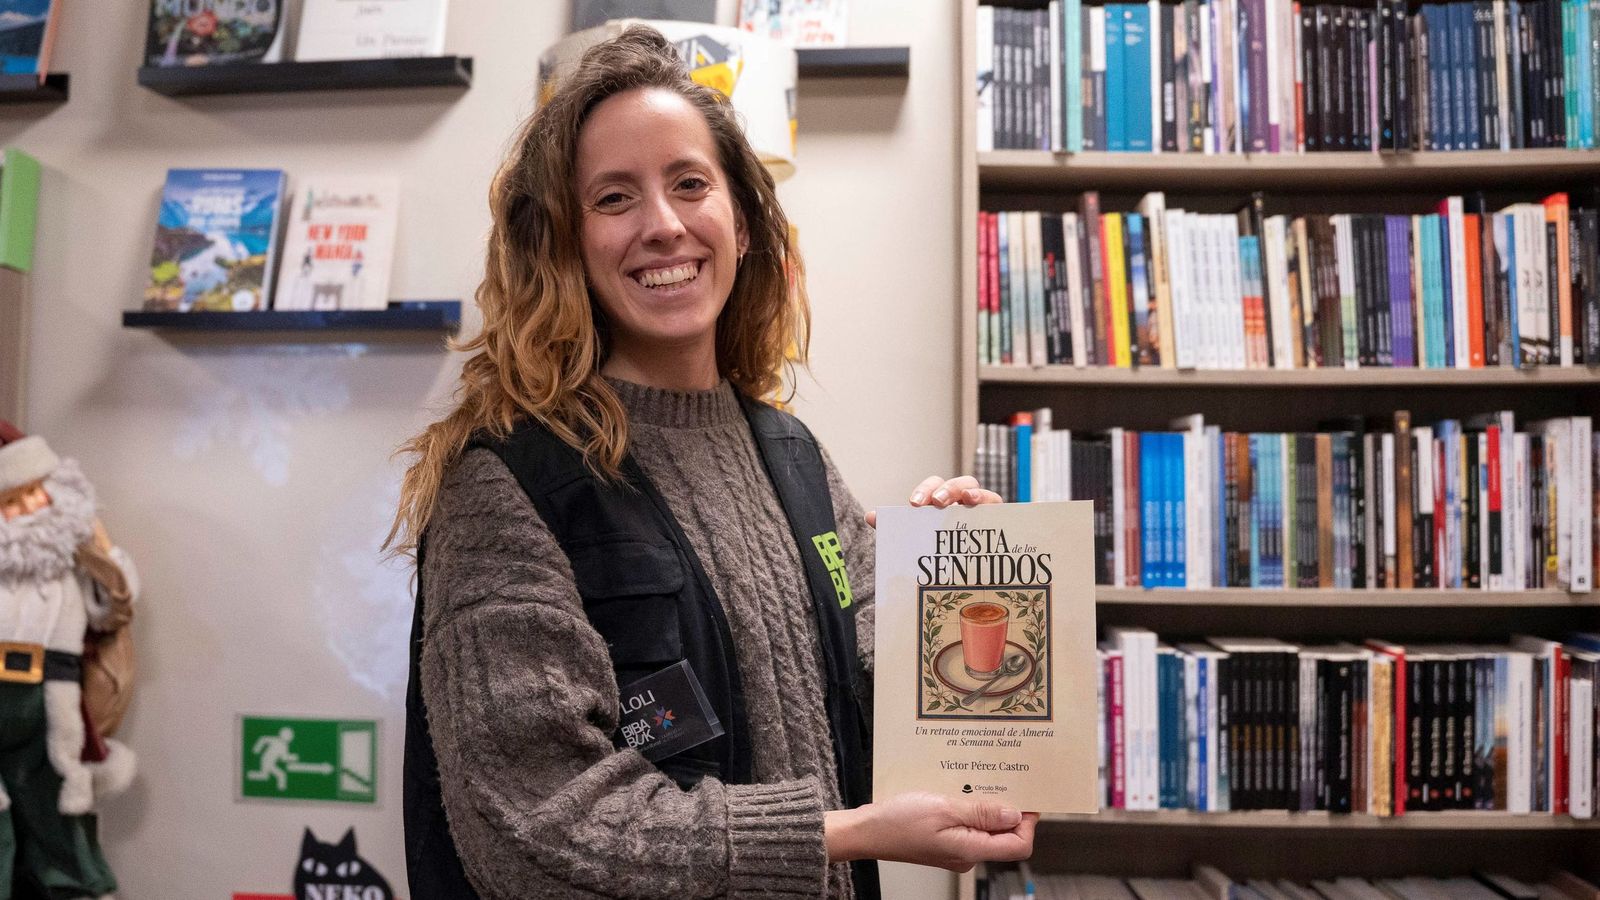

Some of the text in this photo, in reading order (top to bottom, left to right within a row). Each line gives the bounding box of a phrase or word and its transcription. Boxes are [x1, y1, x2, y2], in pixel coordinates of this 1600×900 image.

[955, 521, 967, 530] La
[934, 528, 1037, 555] FIESTA de los
[916, 553, 1053, 586] SENTIDOS
[620, 690, 656, 715] LOLI
[620, 718, 651, 739] BIBA
[626, 728, 656, 748] BUK
[915, 726, 1054, 737] Un retrato emocional de Almería
[959, 737, 994, 747] Semana
[996, 738, 1022, 747] Santa
[940, 760, 1030, 771] Víctor Pérez Castro
